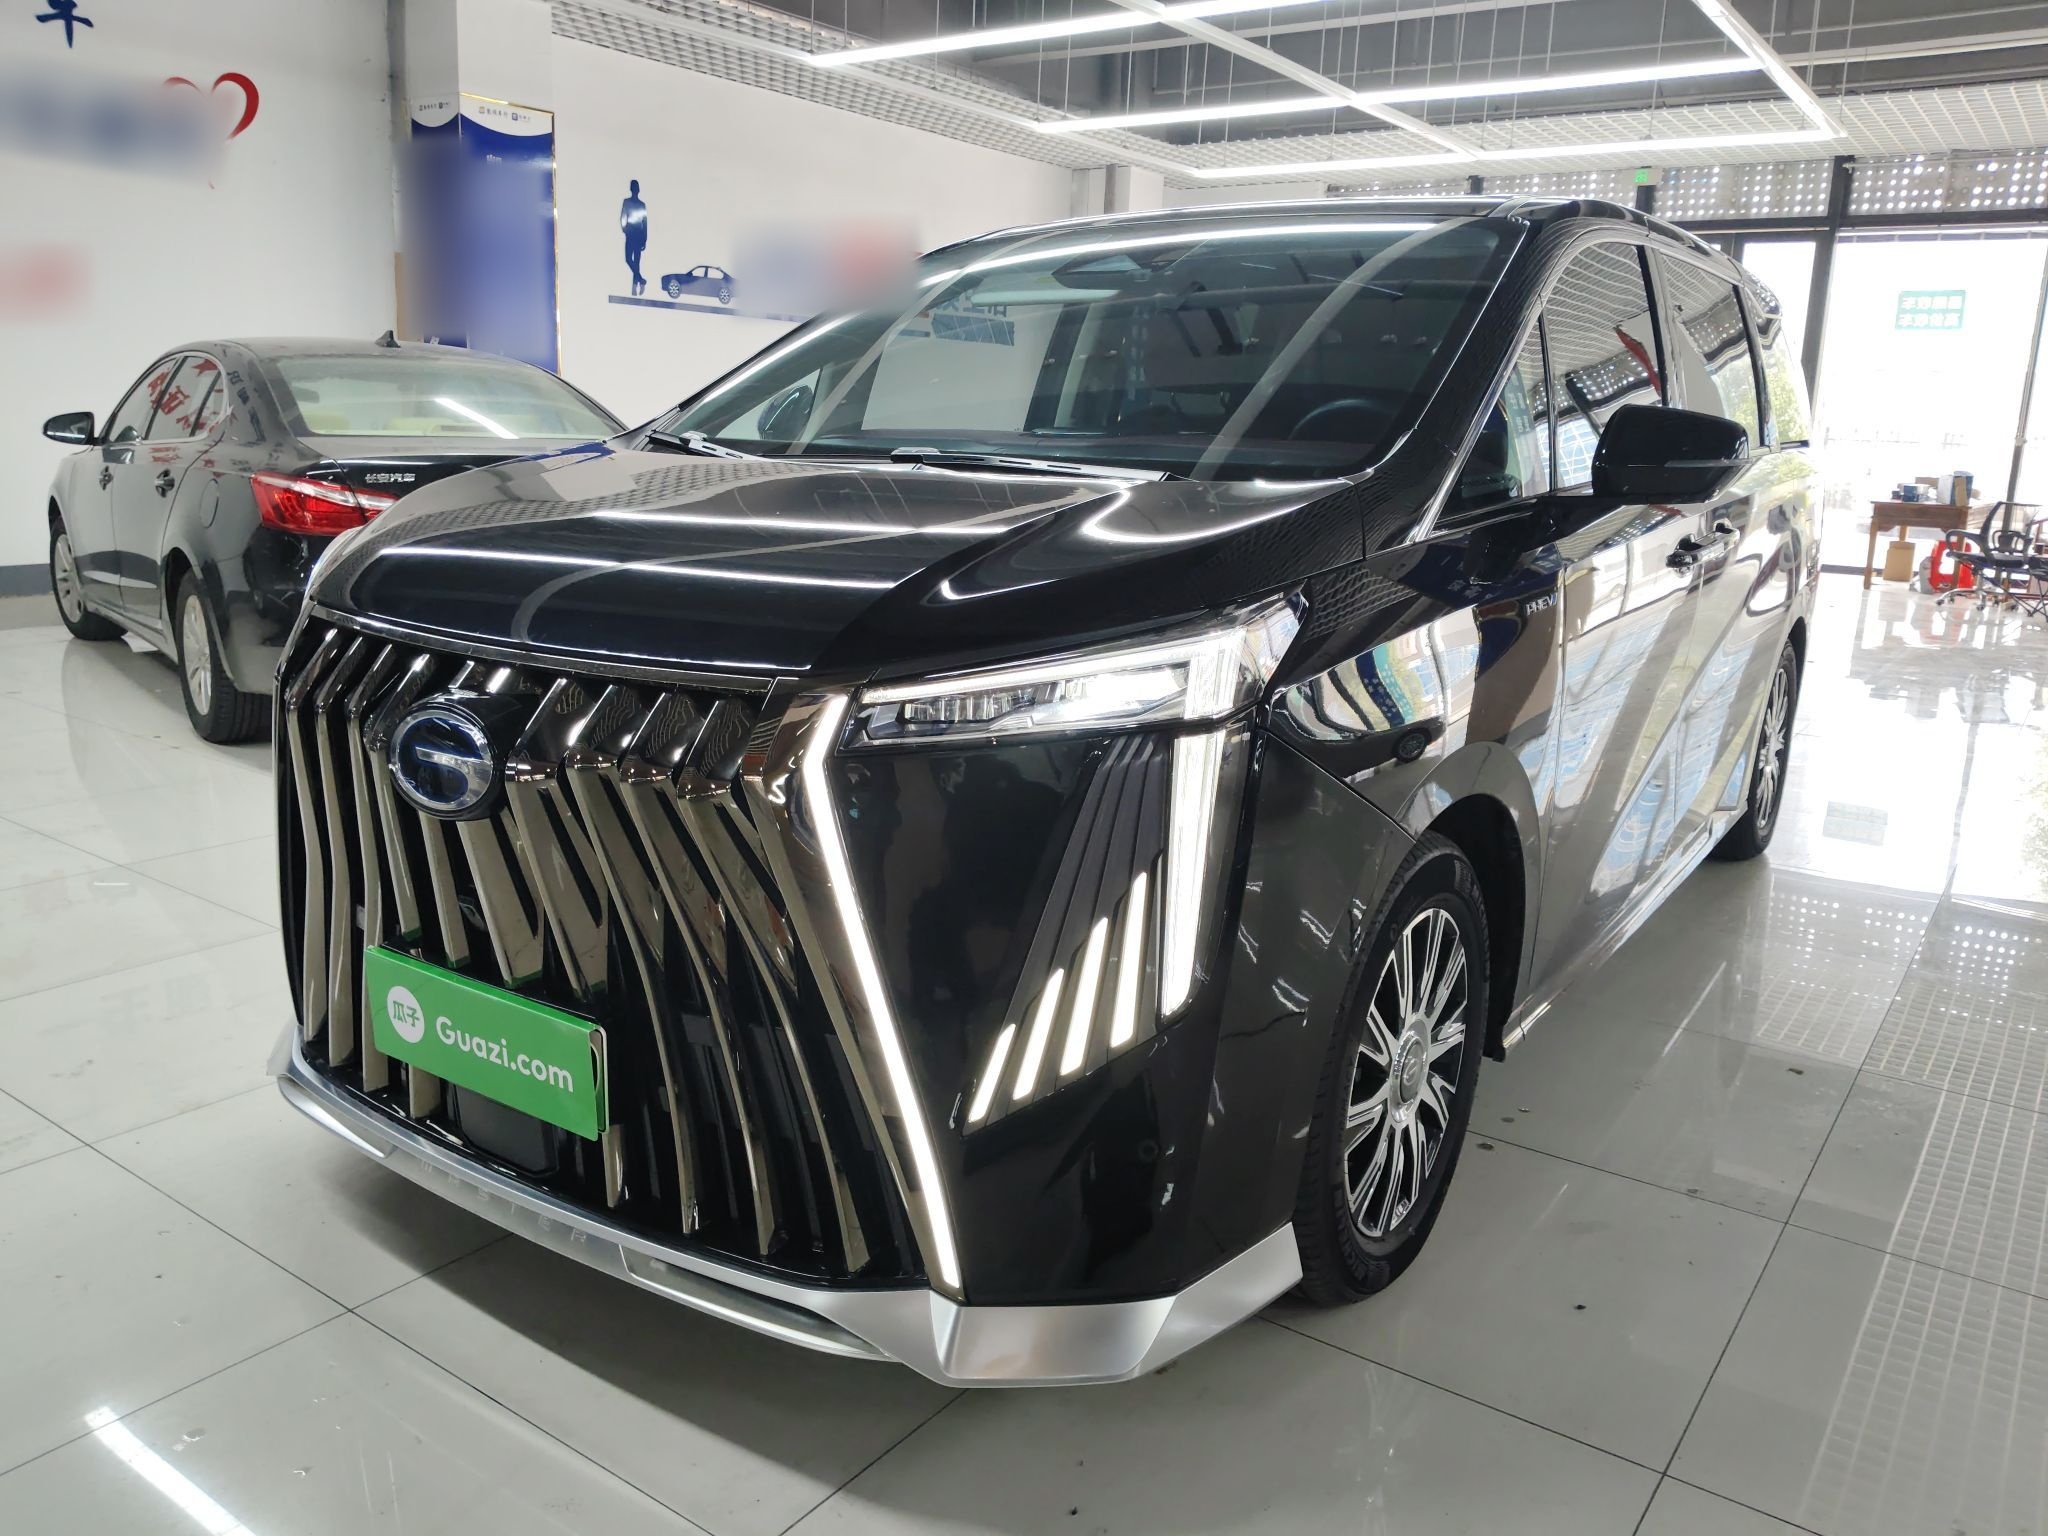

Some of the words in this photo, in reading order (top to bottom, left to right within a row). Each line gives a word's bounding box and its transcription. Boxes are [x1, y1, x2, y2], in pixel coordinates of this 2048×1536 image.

[364, 472, 416, 483] 长安汽车
[1525, 592, 1558, 616] PHEV
[392, 1000, 421, 1028] 瓜子
[435, 1015, 574, 1093] Guazi.com
